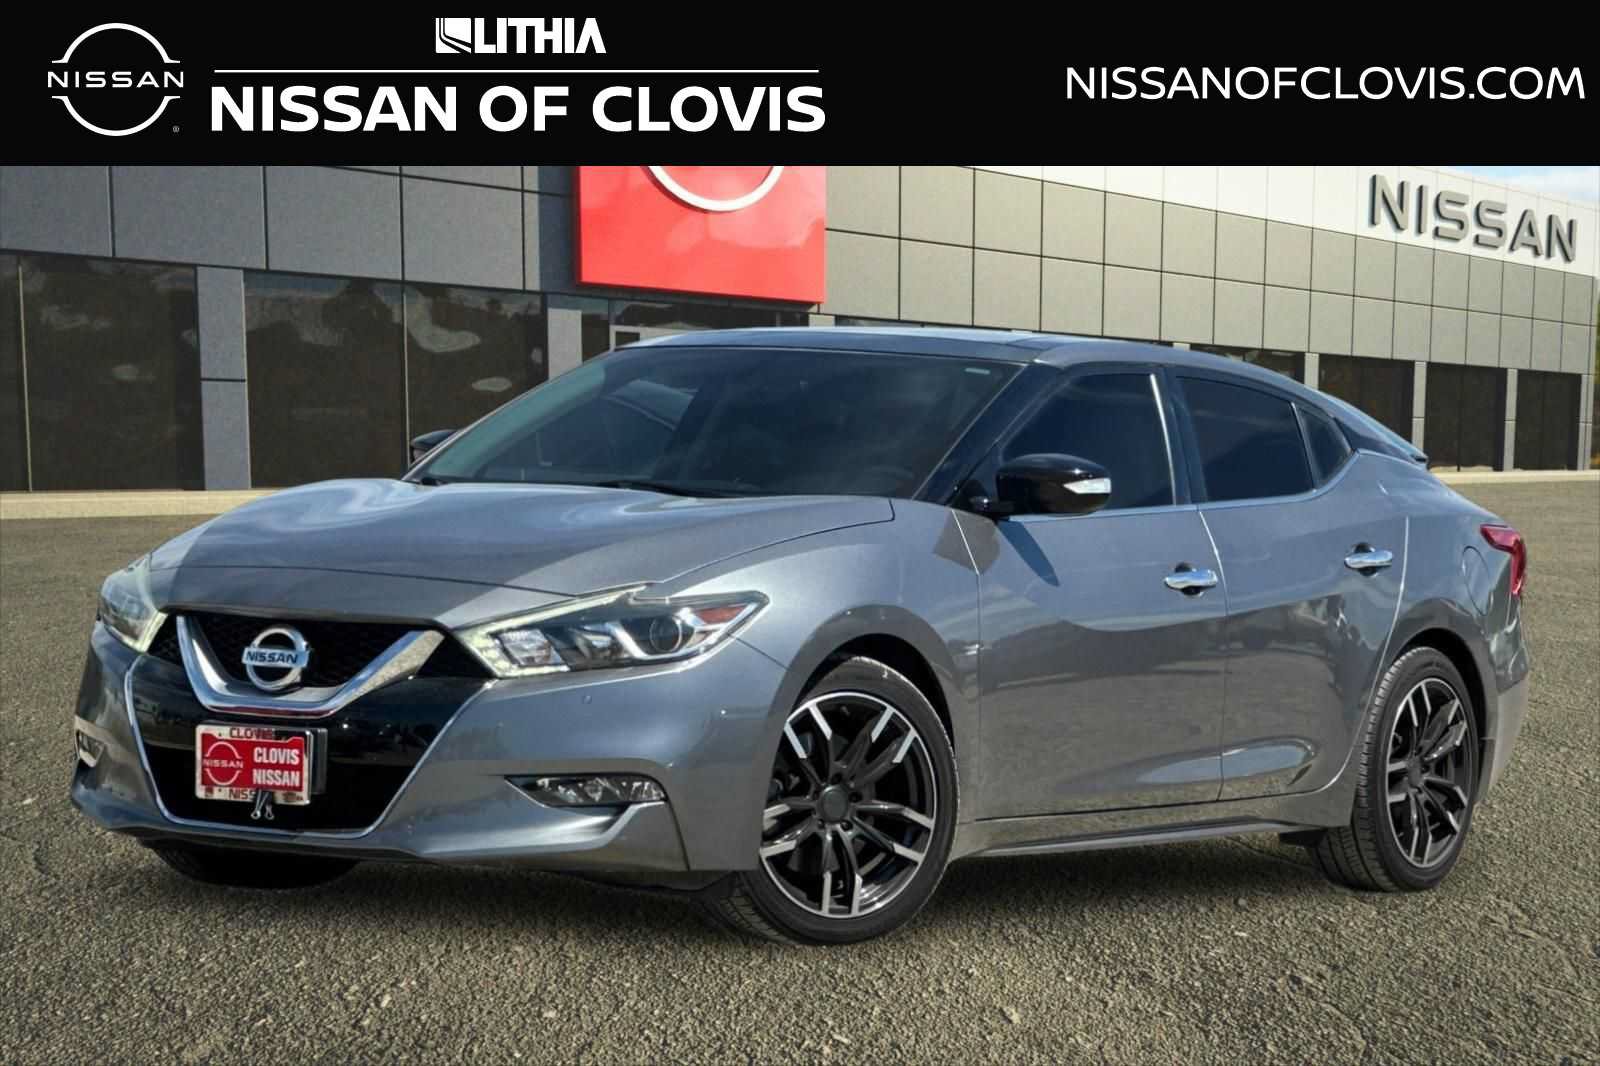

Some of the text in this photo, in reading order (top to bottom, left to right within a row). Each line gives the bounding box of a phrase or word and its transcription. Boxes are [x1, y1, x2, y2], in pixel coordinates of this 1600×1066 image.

[1369, 174, 1577, 262] NISSAN
[246, 651, 299, 664] NISSAN
[202, 759, 243, 769] NISSAN
[253, 747, 300, 766] CLOVIS
[252, 768, 300, 787] NISSAN
